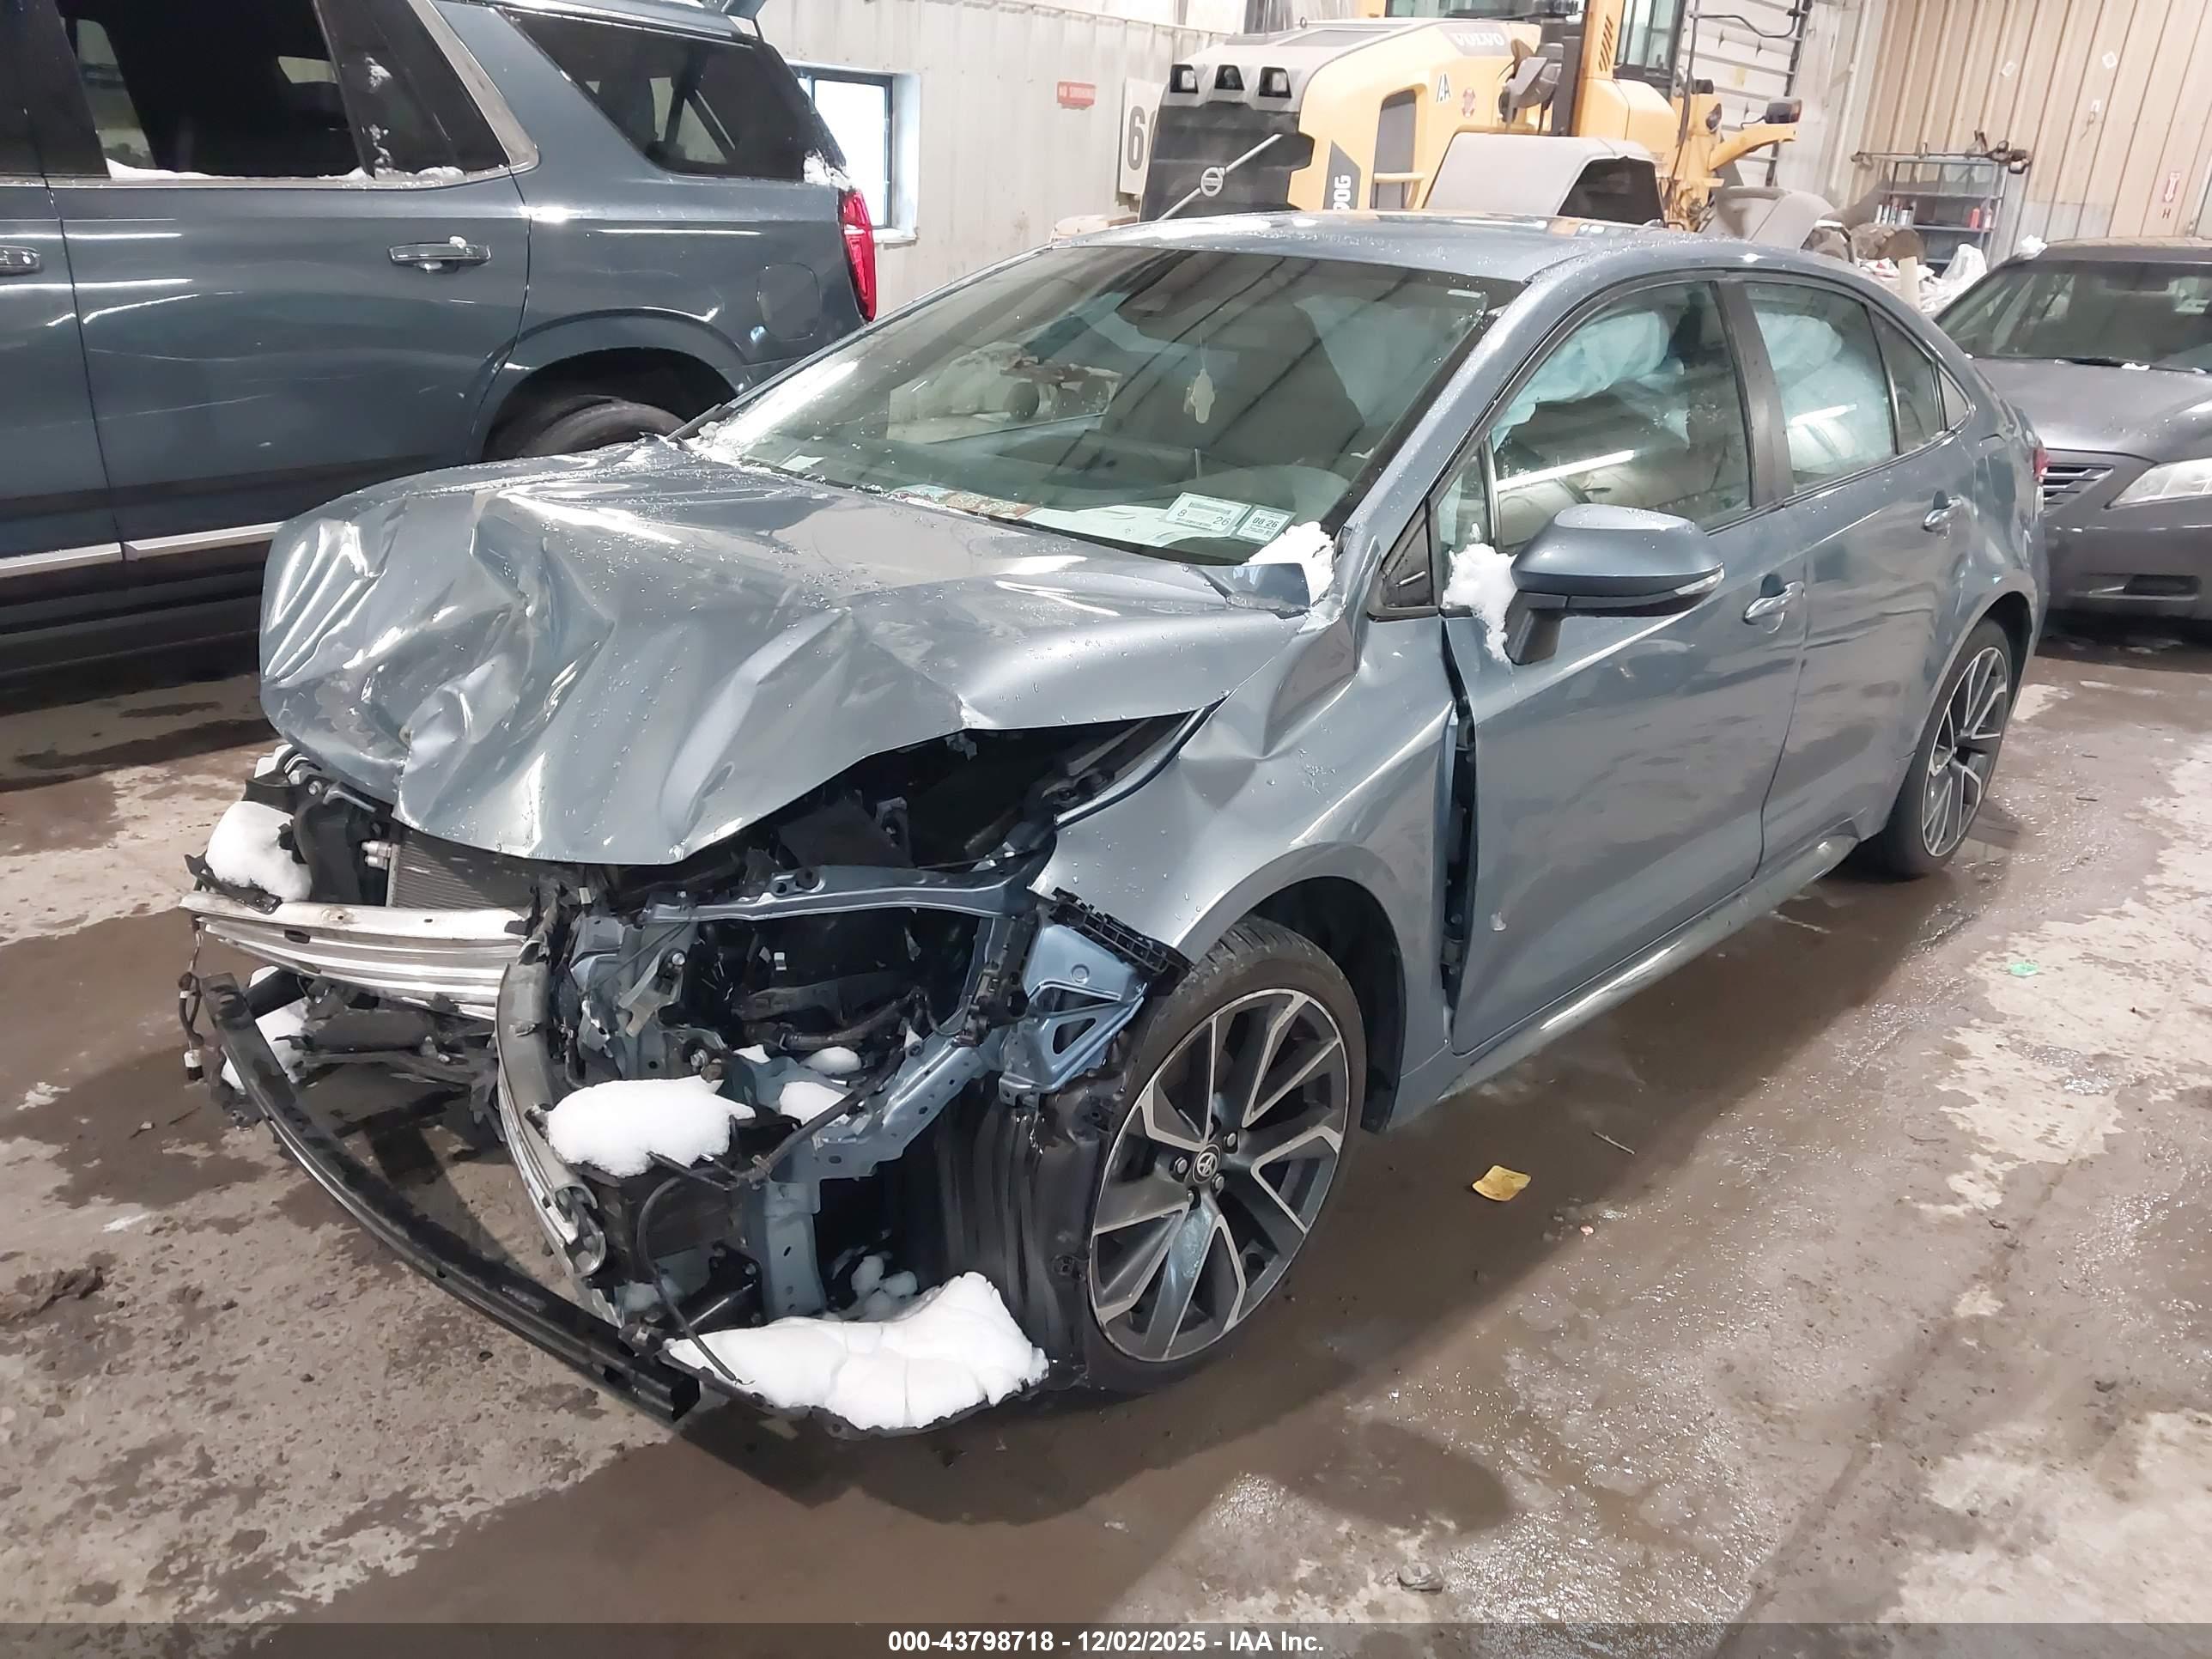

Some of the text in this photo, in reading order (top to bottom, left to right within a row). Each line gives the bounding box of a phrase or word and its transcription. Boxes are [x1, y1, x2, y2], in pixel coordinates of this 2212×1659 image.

[1450, 33, 1505, 46] VOLVO
[1177, 508, 1188, 517] 8
[1212, 516, 1231, 526] 26
